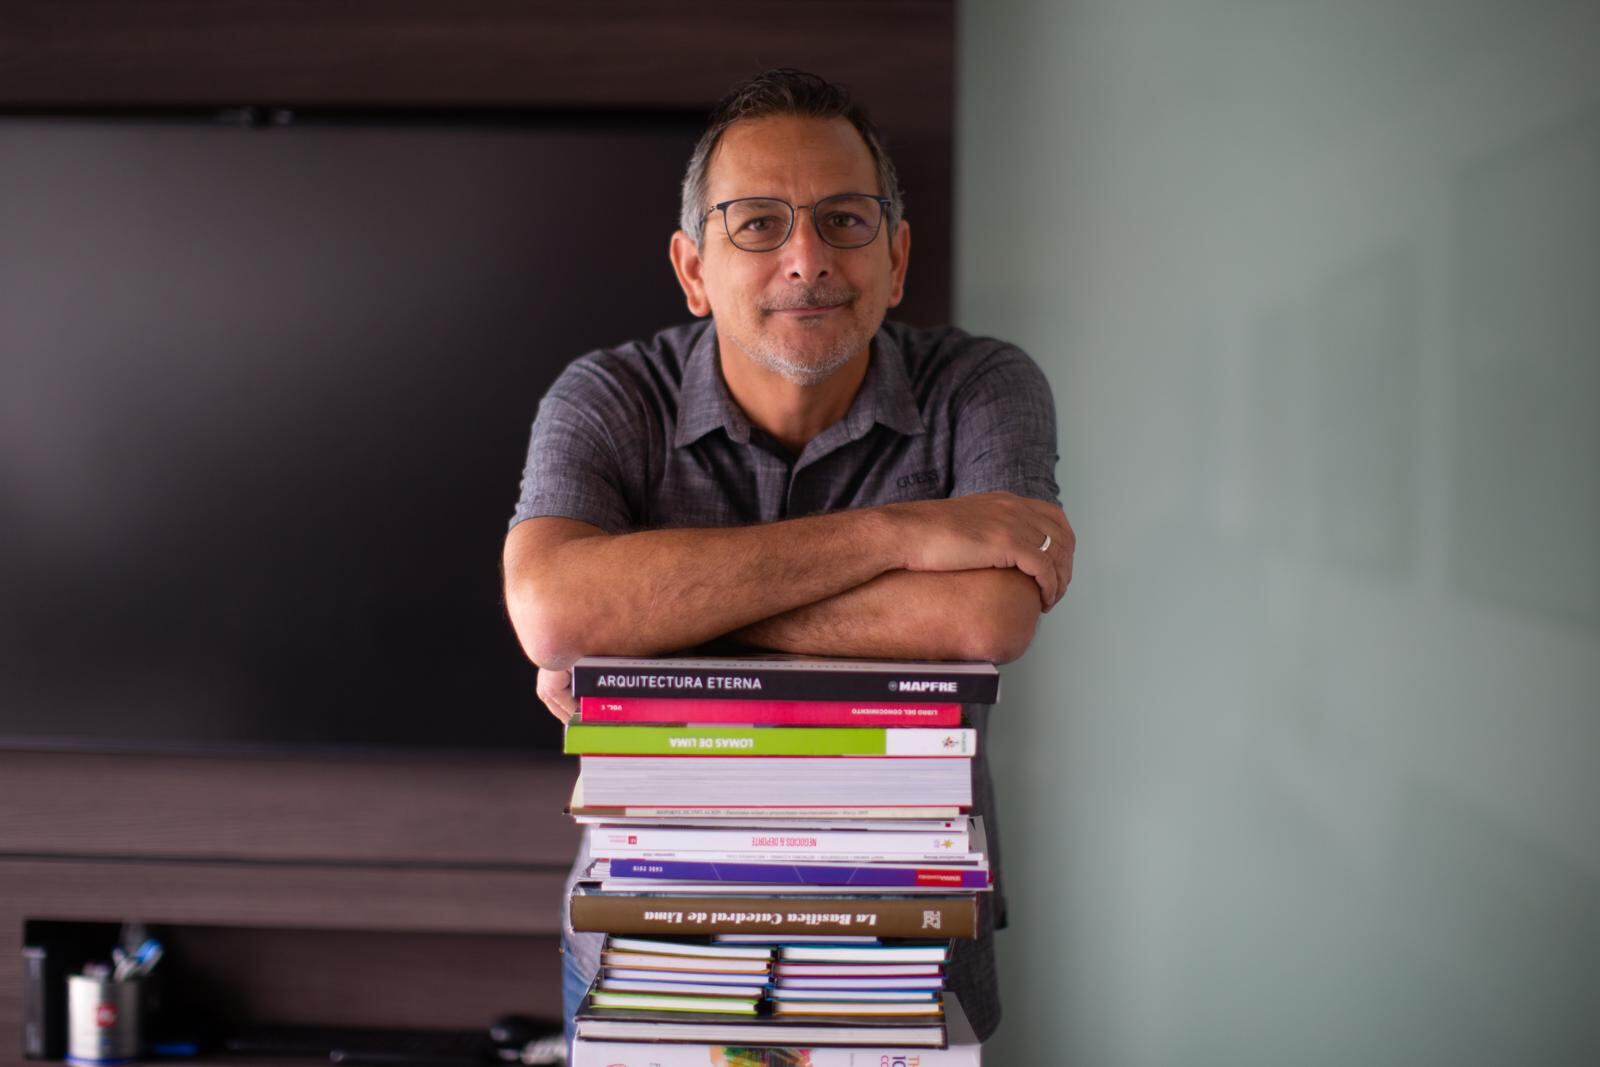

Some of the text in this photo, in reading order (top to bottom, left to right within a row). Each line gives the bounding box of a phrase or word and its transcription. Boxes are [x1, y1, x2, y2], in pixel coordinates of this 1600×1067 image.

[597, 675, 762, 690] ARQUITECTURA ETERNA
[899, 681, 958, 692] MAPFRE
[903, 708, 917, 716] DEL
[669, 737, 754, 748] LOMAS DE LIMA
[751, 836, 779, 847] DEPORTE
[785, 836, 817, 847] NEGOCIOS
[644, 911, 683, 923] Lima
[688, 912, 708, 923] de
[711, 912, 783, 925] Catedral
[856, 913, 877, 925] La
